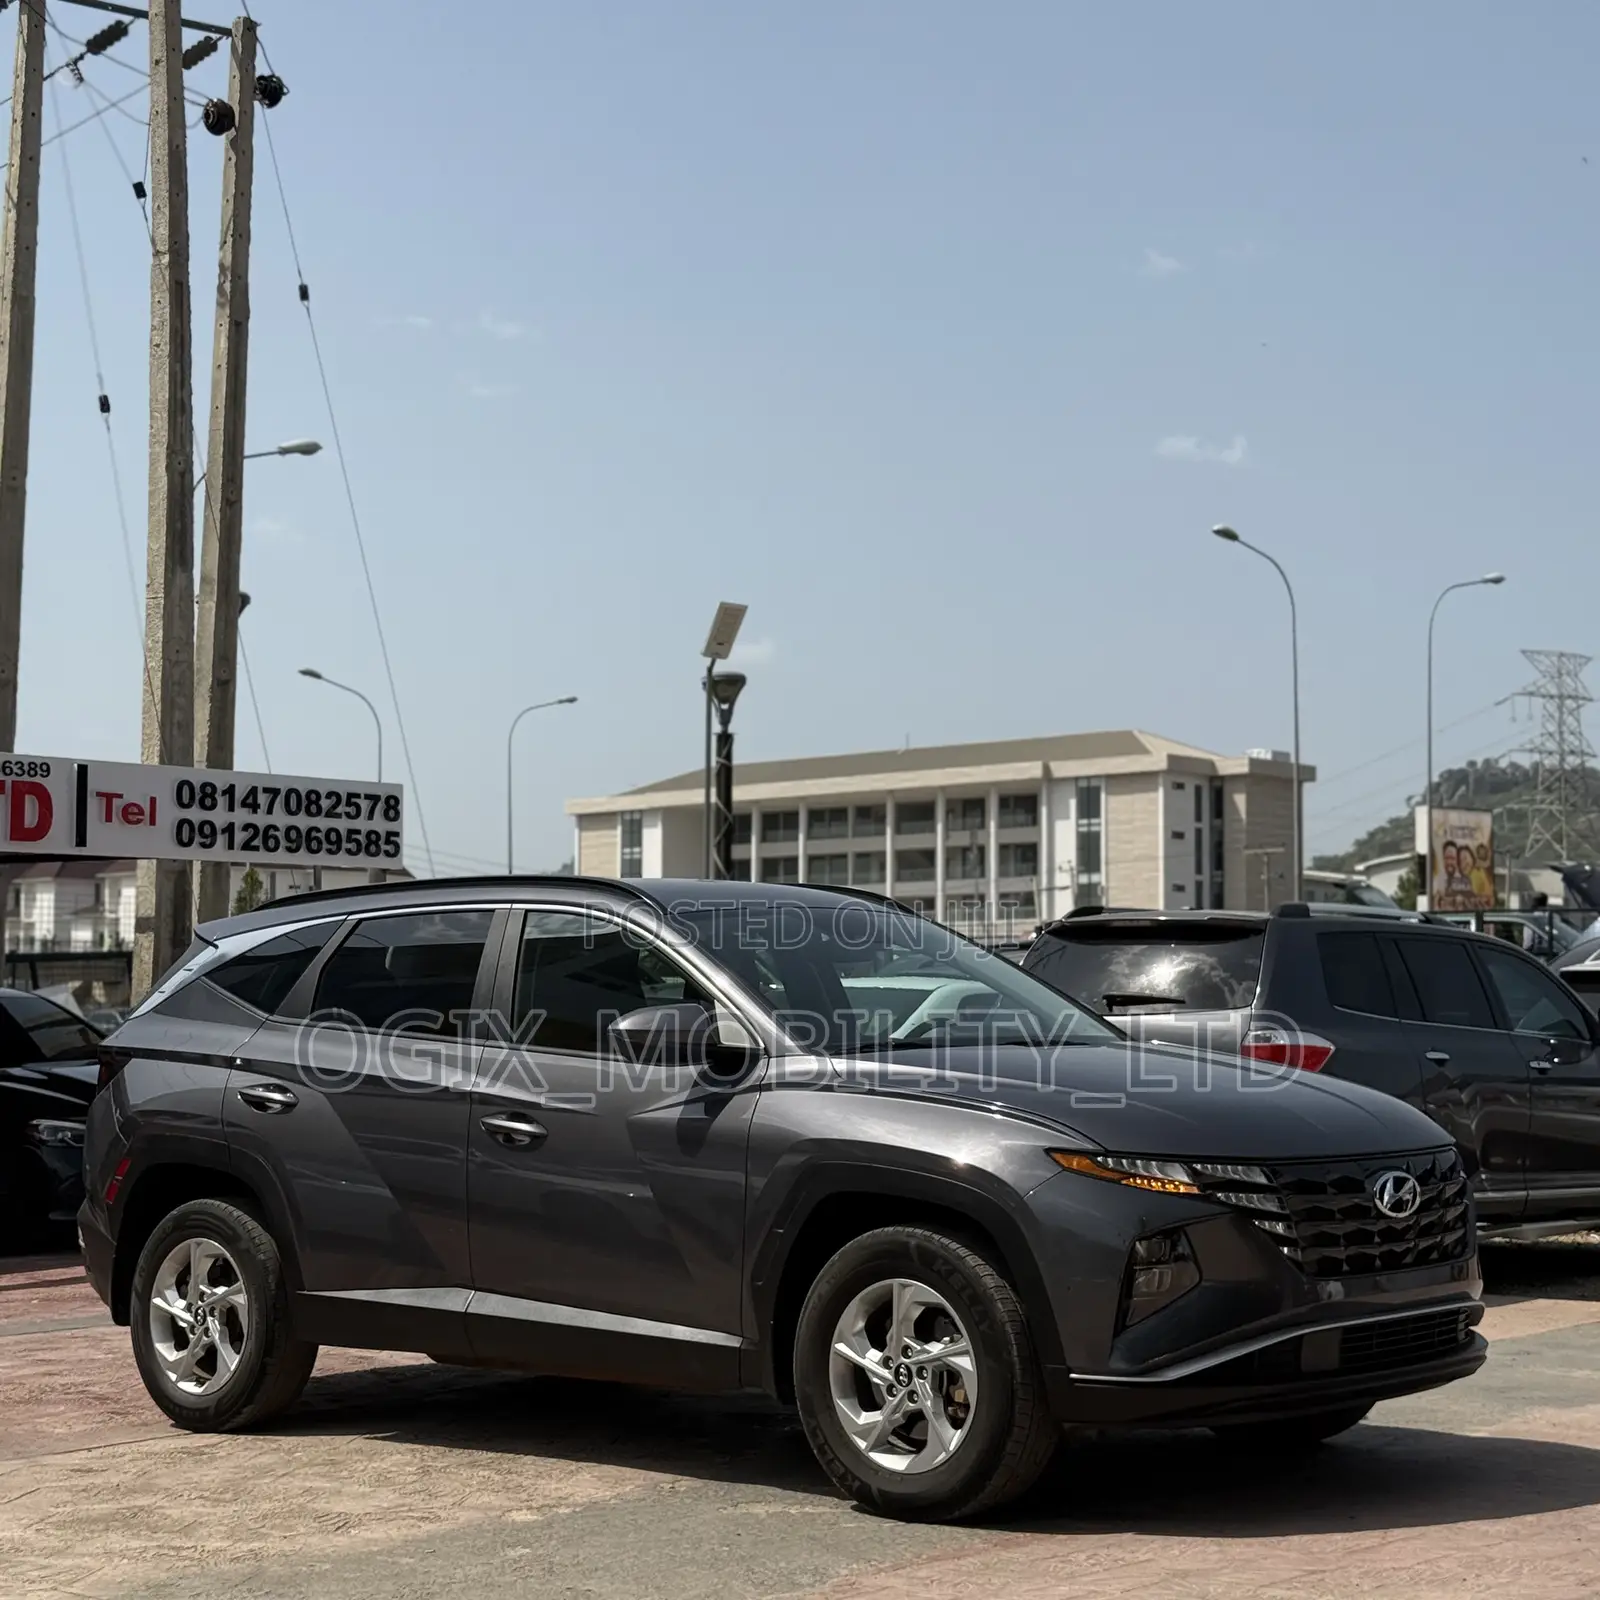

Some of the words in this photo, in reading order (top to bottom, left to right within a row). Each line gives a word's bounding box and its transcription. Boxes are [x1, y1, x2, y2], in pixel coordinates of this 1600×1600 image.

[0, 760, 50, 778] 6389
[96, 791, 157, 826] Tel
[175, 779, 400, 822] 08147082578
[175, 818, 400, 858] 09126969585
[931, 1257, 994, 1334] KELLY
